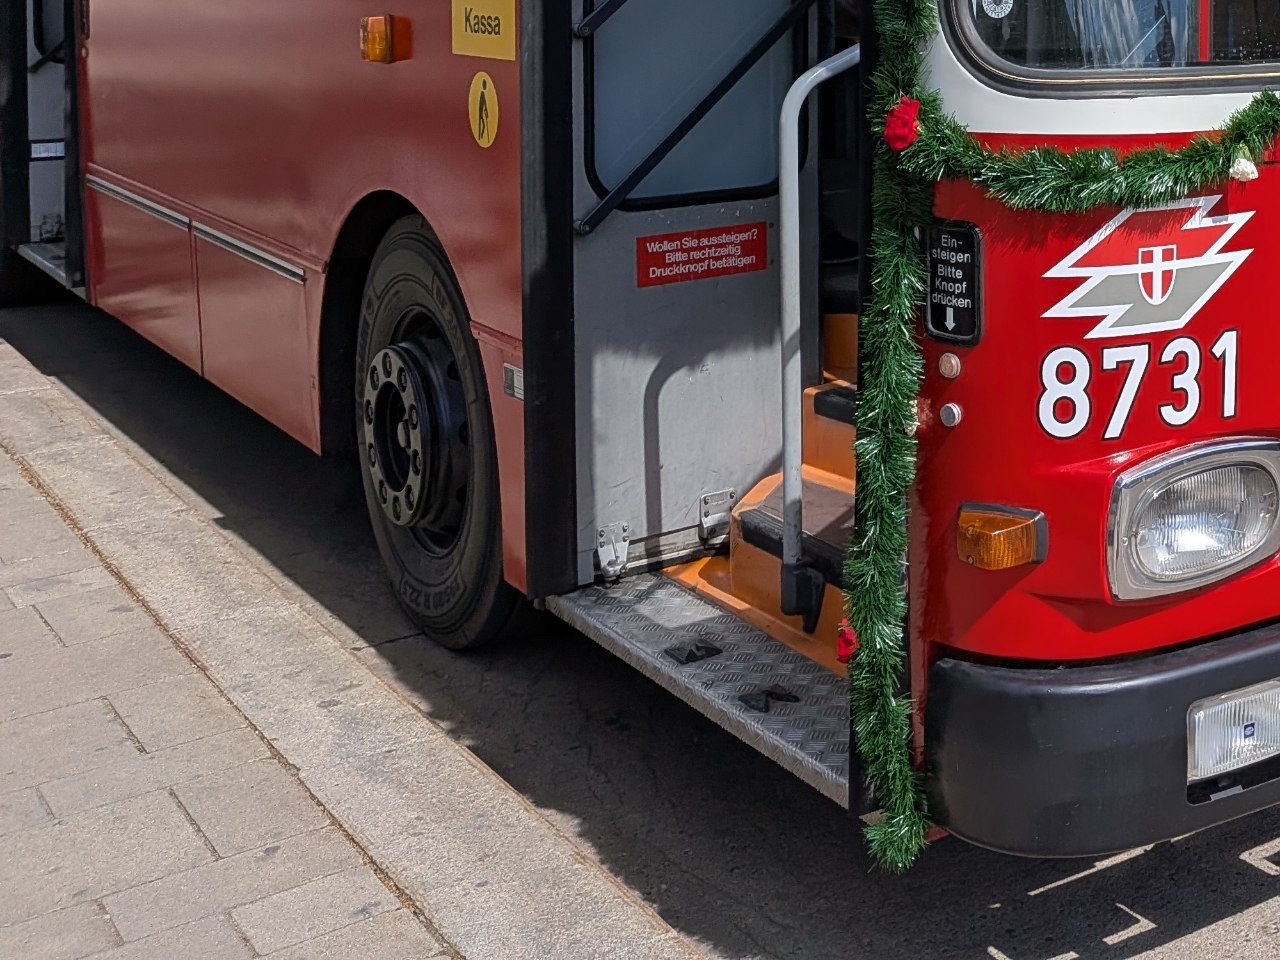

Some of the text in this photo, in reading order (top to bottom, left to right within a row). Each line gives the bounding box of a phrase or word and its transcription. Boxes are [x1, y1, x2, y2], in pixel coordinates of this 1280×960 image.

[464, 7, 501, 36] Kassa
[647, 229, 758, 253] Wollen Sie aussteigen?
[941, 234, 963, 248] Ein-
[665, 244, 741, 264] Bitte rechtzeitig
[932, 248, 971, 264] steigen
[649, 255, 756, 278] Druckknopf betätigen
[937, 263, 963, 279] Bitte
[935, 277, 967, 294] Knopf
[931, 291, 972, 308] drücken
[1036, 328, 1239, 441] 8731
